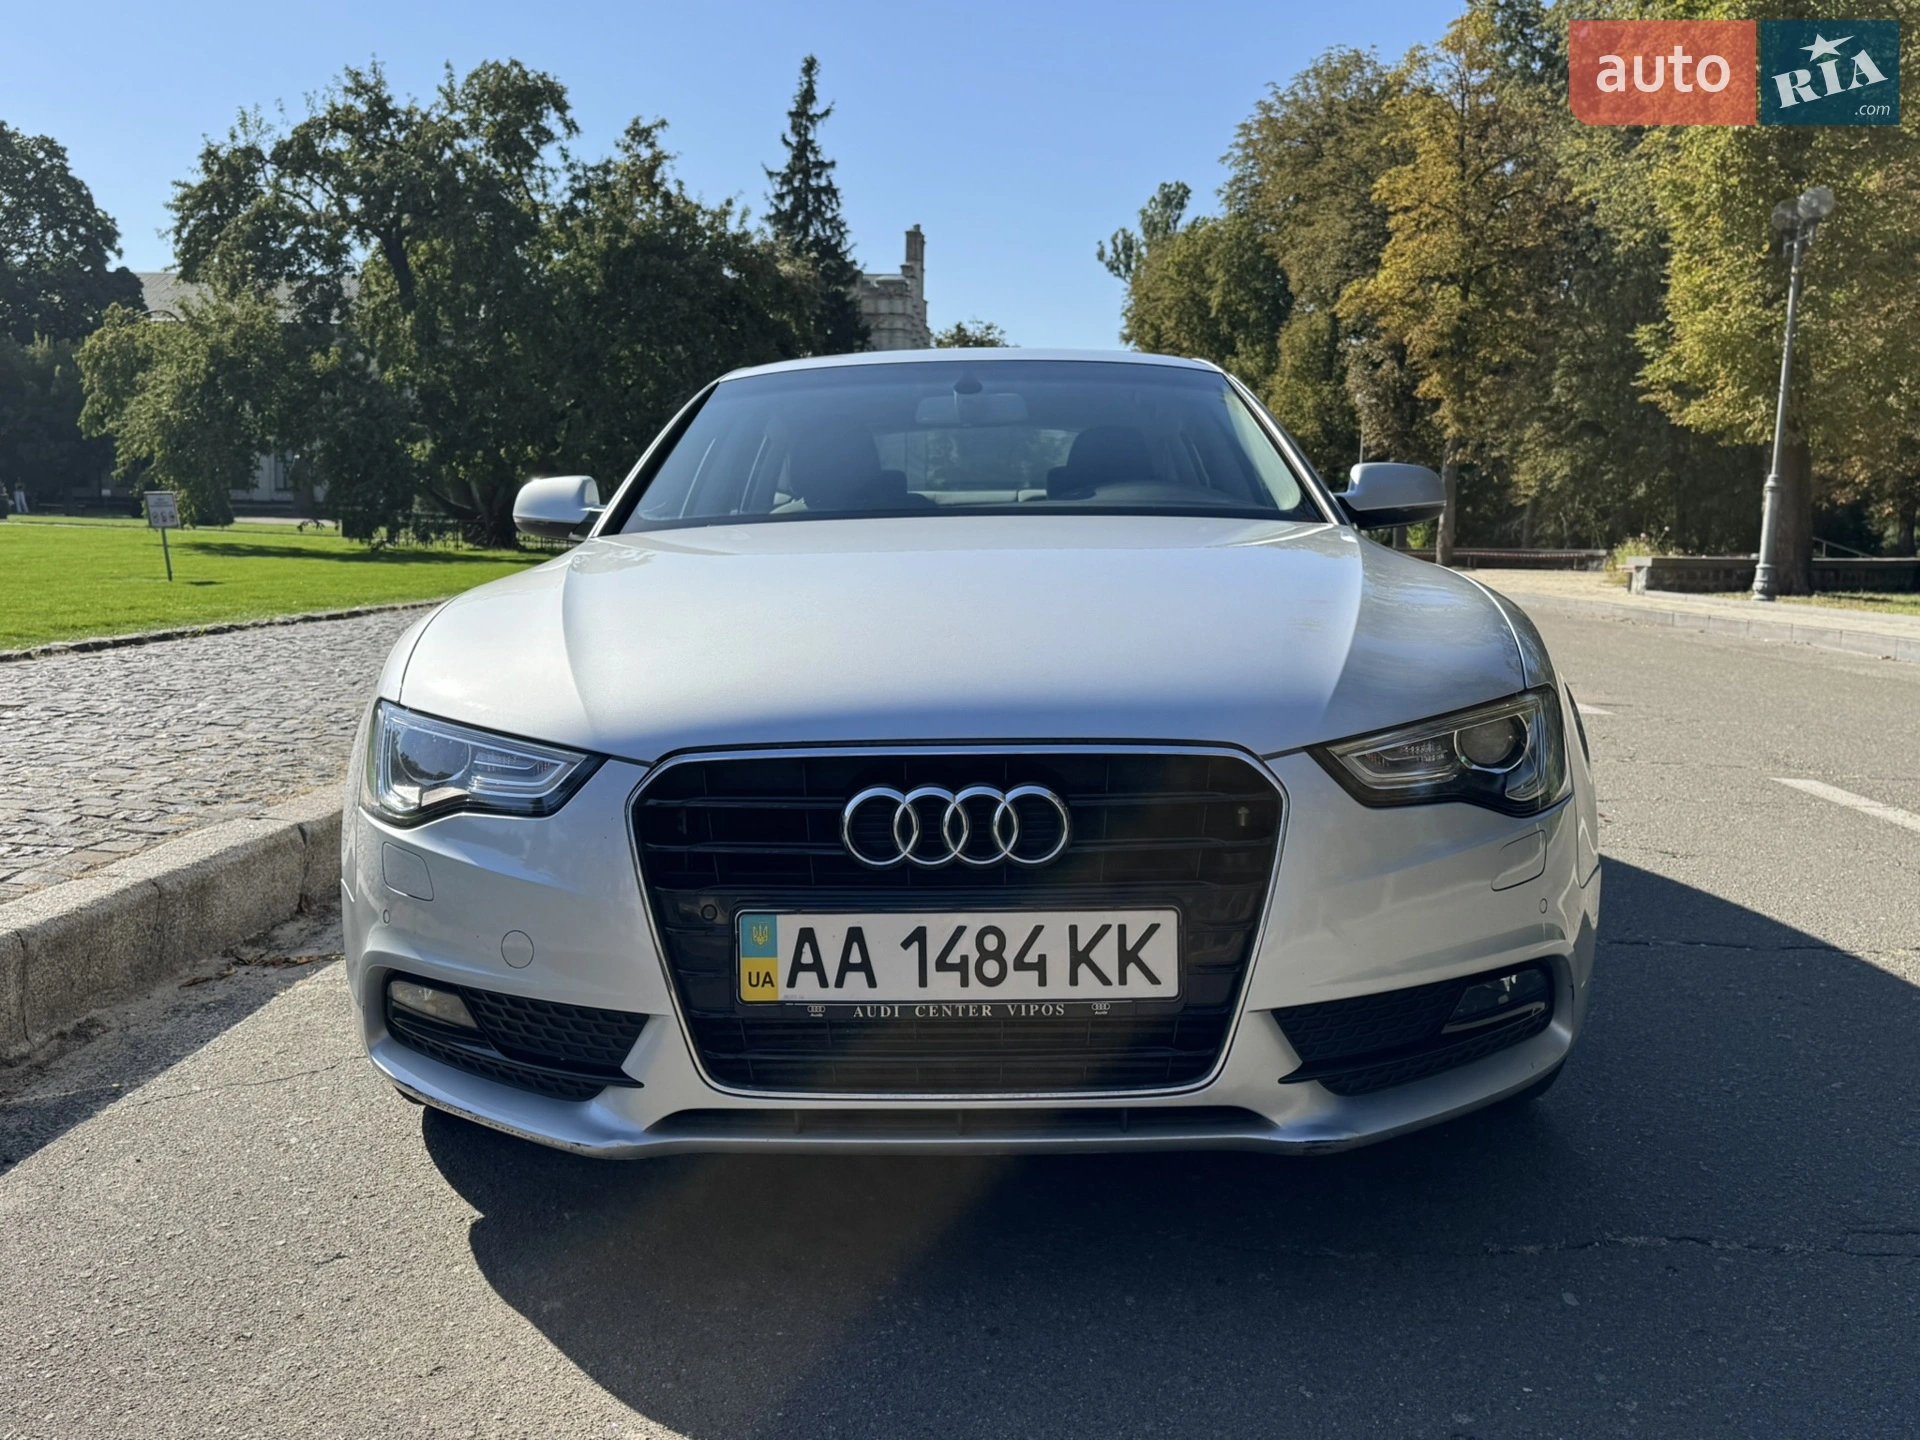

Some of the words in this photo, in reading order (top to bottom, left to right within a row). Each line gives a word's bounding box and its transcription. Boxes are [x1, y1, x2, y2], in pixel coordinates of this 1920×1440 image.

[786, 926, 878, 989] AA
[900, 925, 1048, 988] 1484
[1068, 923, 1162, 986] KK
[748, 971, 775, 988] UA
[853, 1005, 900, 1018] AUDI
[914, 1004, 993, 1017] CENTER
[1007, 1003, 1065, 1016] VIPOS
